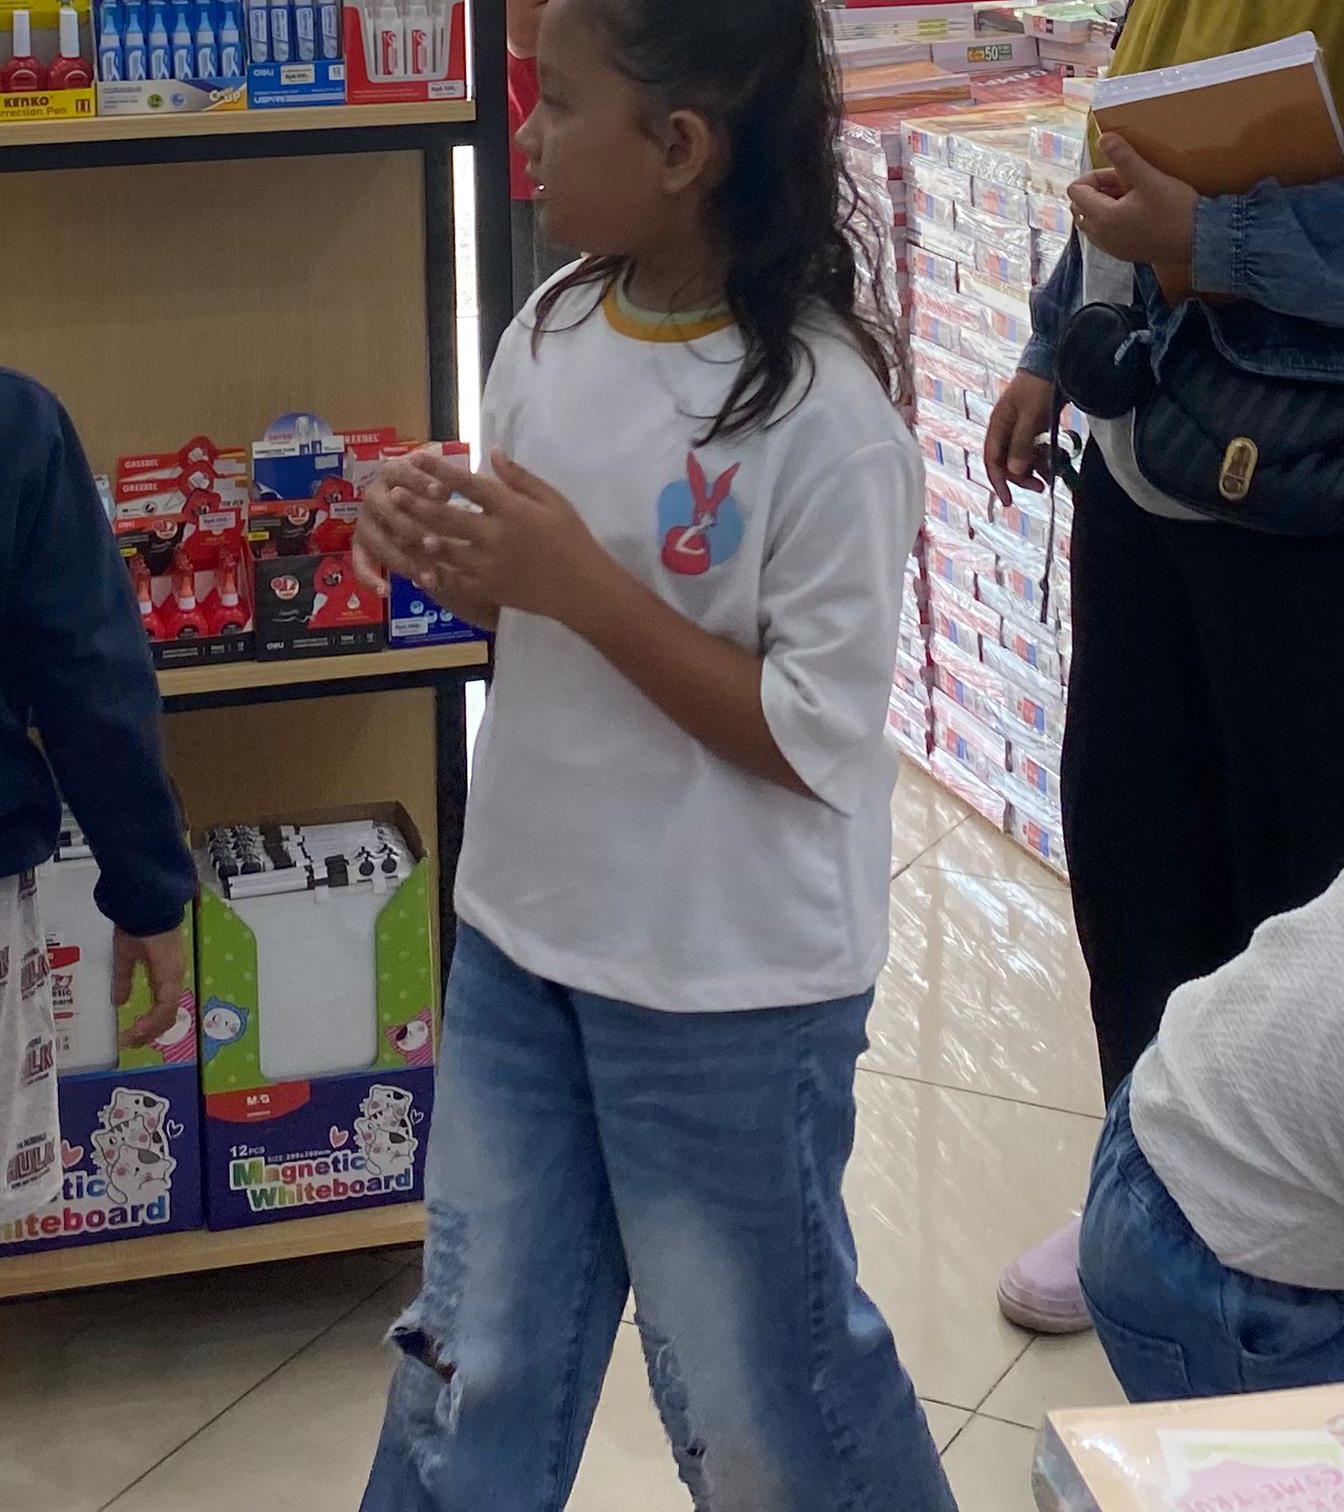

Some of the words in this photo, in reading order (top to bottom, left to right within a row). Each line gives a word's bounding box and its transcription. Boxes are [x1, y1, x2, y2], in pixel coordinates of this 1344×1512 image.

[984, 46, 999, 62] 50
[3, 97, 50, 108] KENKO
[45, 106, 67, 116] Pen
[7, 1137, 56, 1185] HULK
[232, 1151, 369, 1189] Magnetic
[250, 1167, 413, 1209] Whiteboard
[1259, 1467, 1343, 1500] COME
